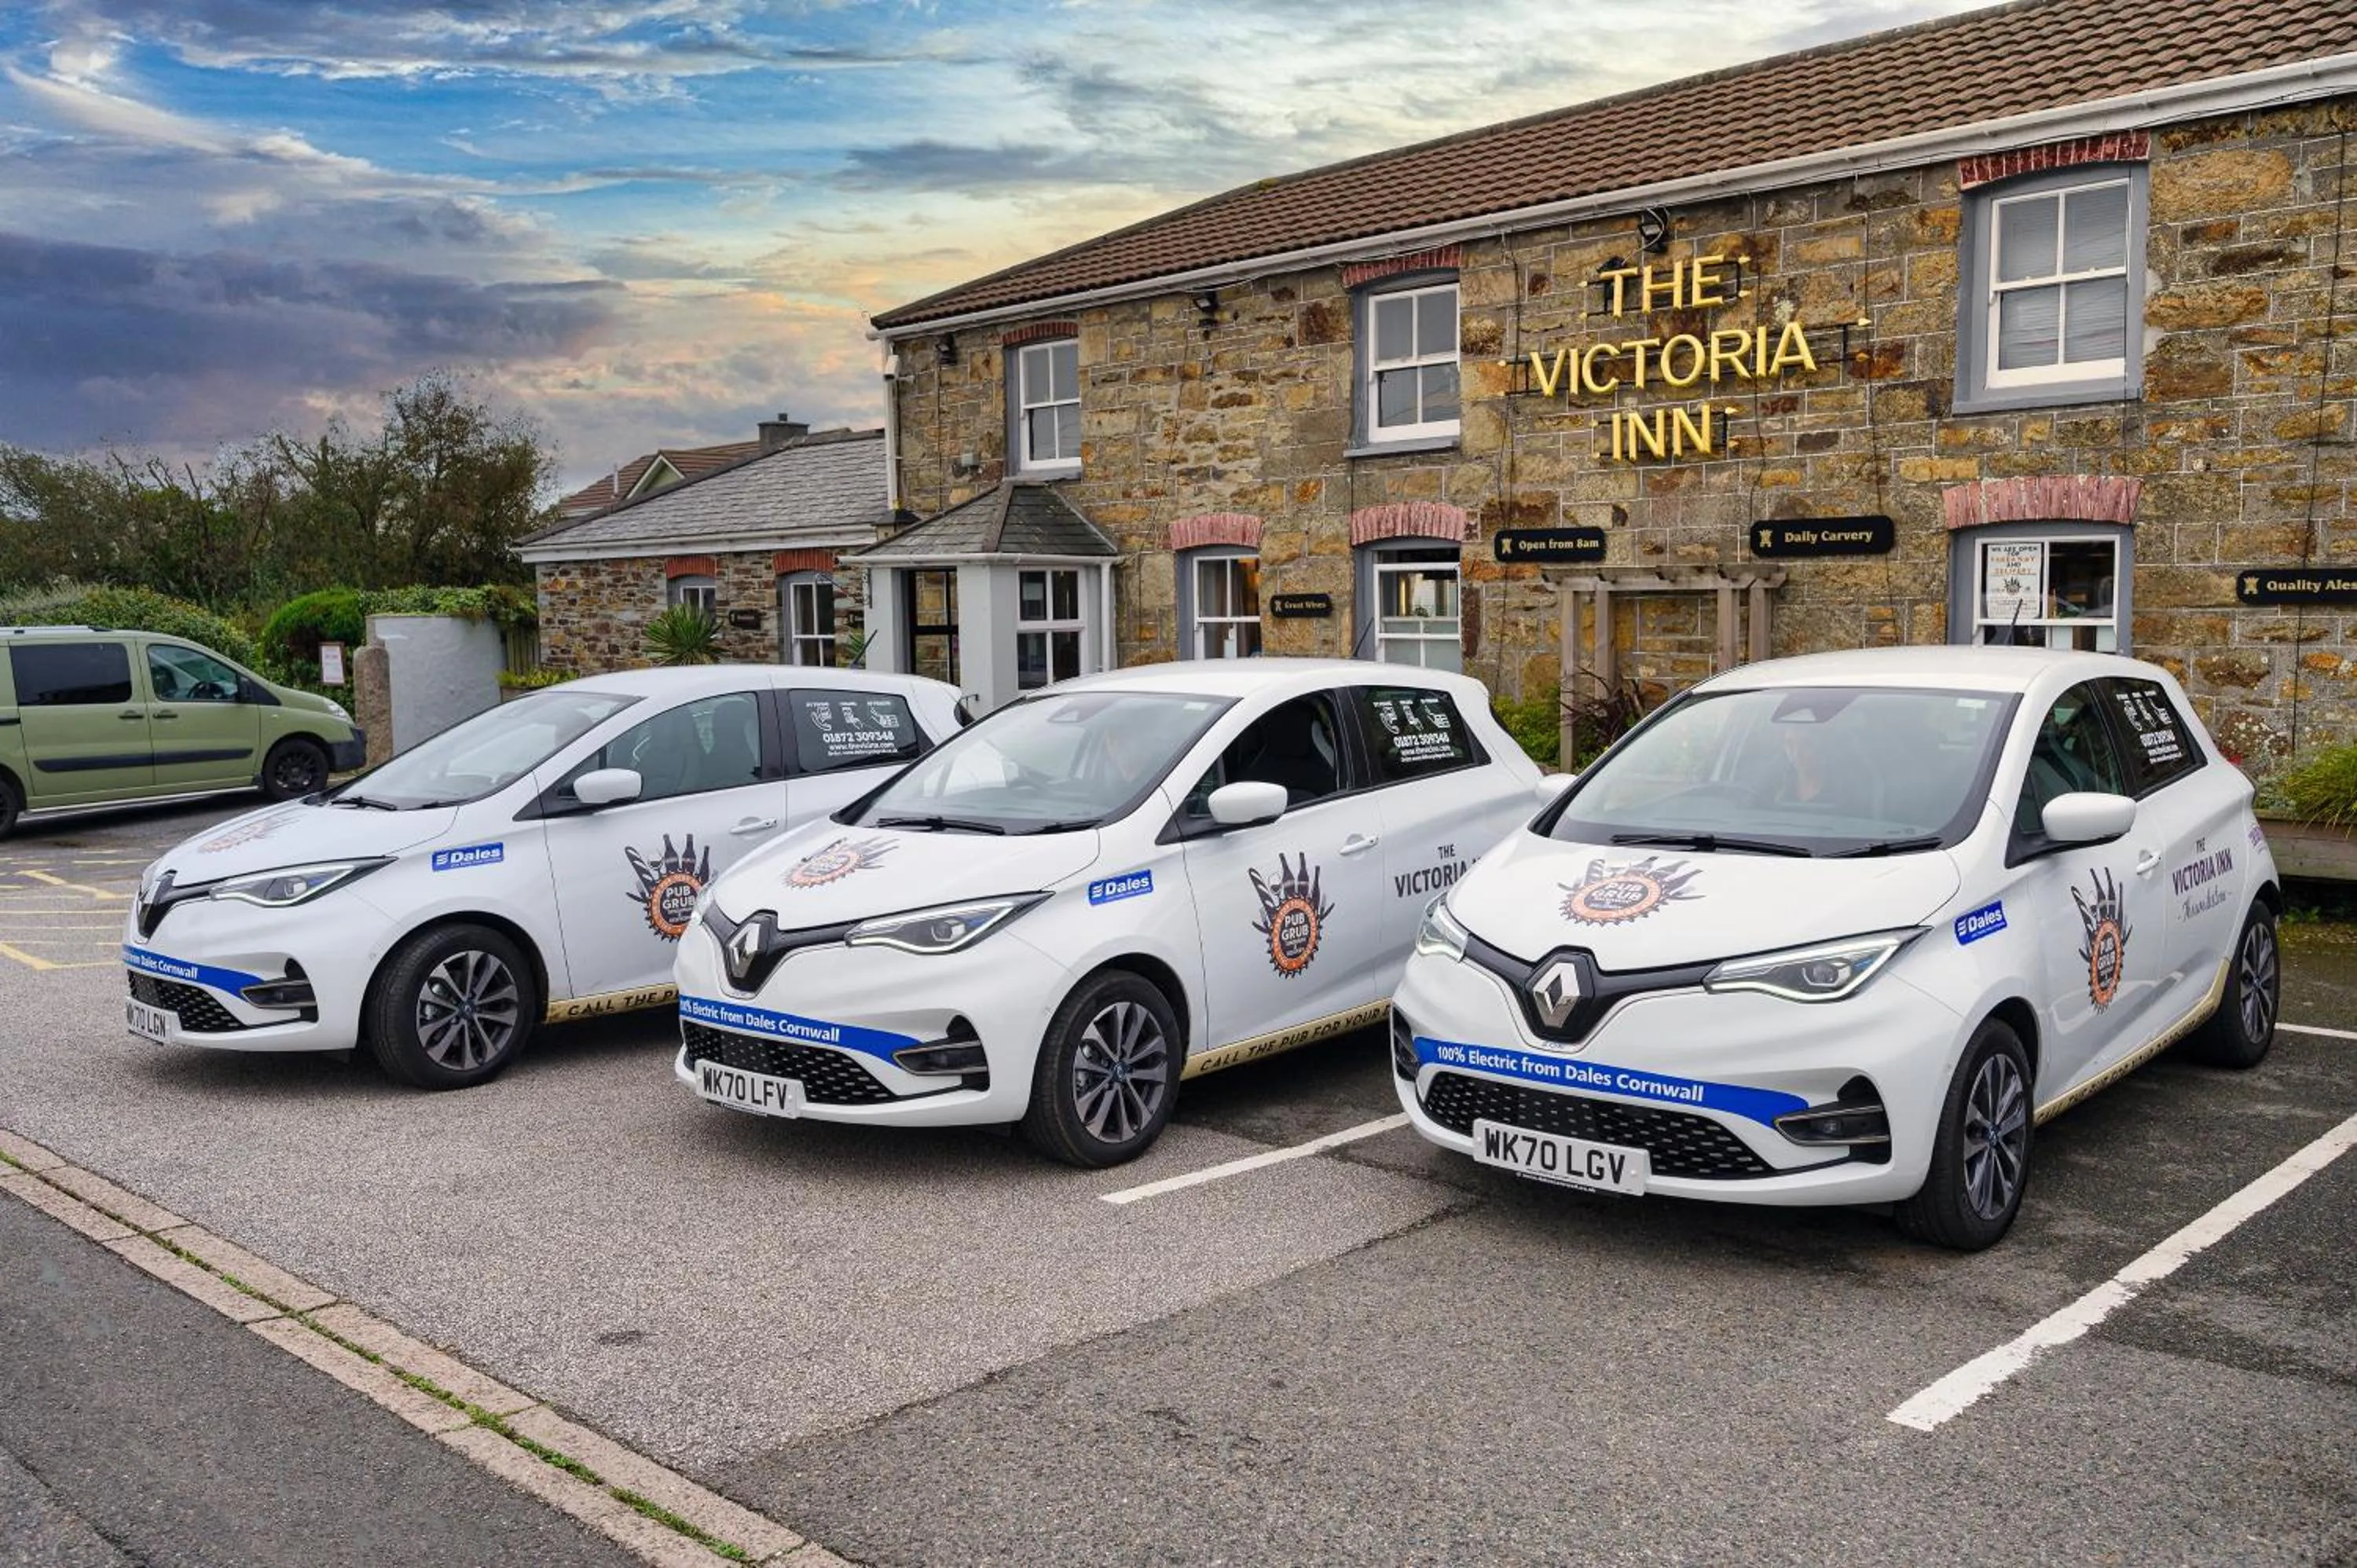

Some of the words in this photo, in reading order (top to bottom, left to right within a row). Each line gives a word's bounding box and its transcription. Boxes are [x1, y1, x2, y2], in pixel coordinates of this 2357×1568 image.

[1599, 254, 1725, 318] THE
[1529, 322, 1816, 397] VICTORIA
[1612, 403, 1712, 462] INN
[1519, 540, 1546, 551] Open
[1549, 538, 1574, 549] from
[1576, 538, 1600, 548] 8am
[1784, 531, 1818, 544] Daily
[1820, 529, 1873, 543] Carvery
[2267, 579, 2322, 593] Quality
[2325, 579, 2357, 590] Ales
[823, 731, 856, 743] 01872
[450, 848, 500, 863] Dales
[1437, 844, 1456, 860] THE
[1395, 860, 1468, 898] VICTORIA
[2172, 855, 2216, 896] VICTORIA
[2215, 848, 2233, 877] INN
[665, 885, 691, 898] PUB
[1105, 877, 1149, 896] Dales
[1604, 881, 1643, 892] PUB
[662, 896, 696, 910] GRUB
[1285, 913, 1305, 929] PUB
[1968, 909, 2003, 932] Dales
[1281, 924, 1310, 940] GRUB
[157, 959, 199, 980] Cornwall
[567, 999, 615, 1017] CALL
[623, 991, 658, 1008] THE
[720, 1008, 745, 1024] from
[746, 1013, 776, 1031] Dales
[779, 1020, 841, 1042] Cornwall
[1200, 1050, 1240, 1072] CALL
[1248, 1039, 1277, 1057] THE
[1280, 1030, 1309, 1050] PUB
[1311, 1020, 1342, 1039] FOR
[1344, 1007, 1380, 1028] YOUR
[1437, 1046, 1465, 1063] 100%
[1468, 1050, 1518, 1072] Electric
[1520, 1060, 1560, 1078] from
[1564, 1066, 1612, 1086] Dales
[1616, 1074, 1705, 1102] Cornwall
[702, 1067, 746, 1101] WK70
[751, 1078, 788, 1110] LFV
[1484, 1127, 1558, 1171] WK70
[1566, 1145, 1626, 1185] LGV
